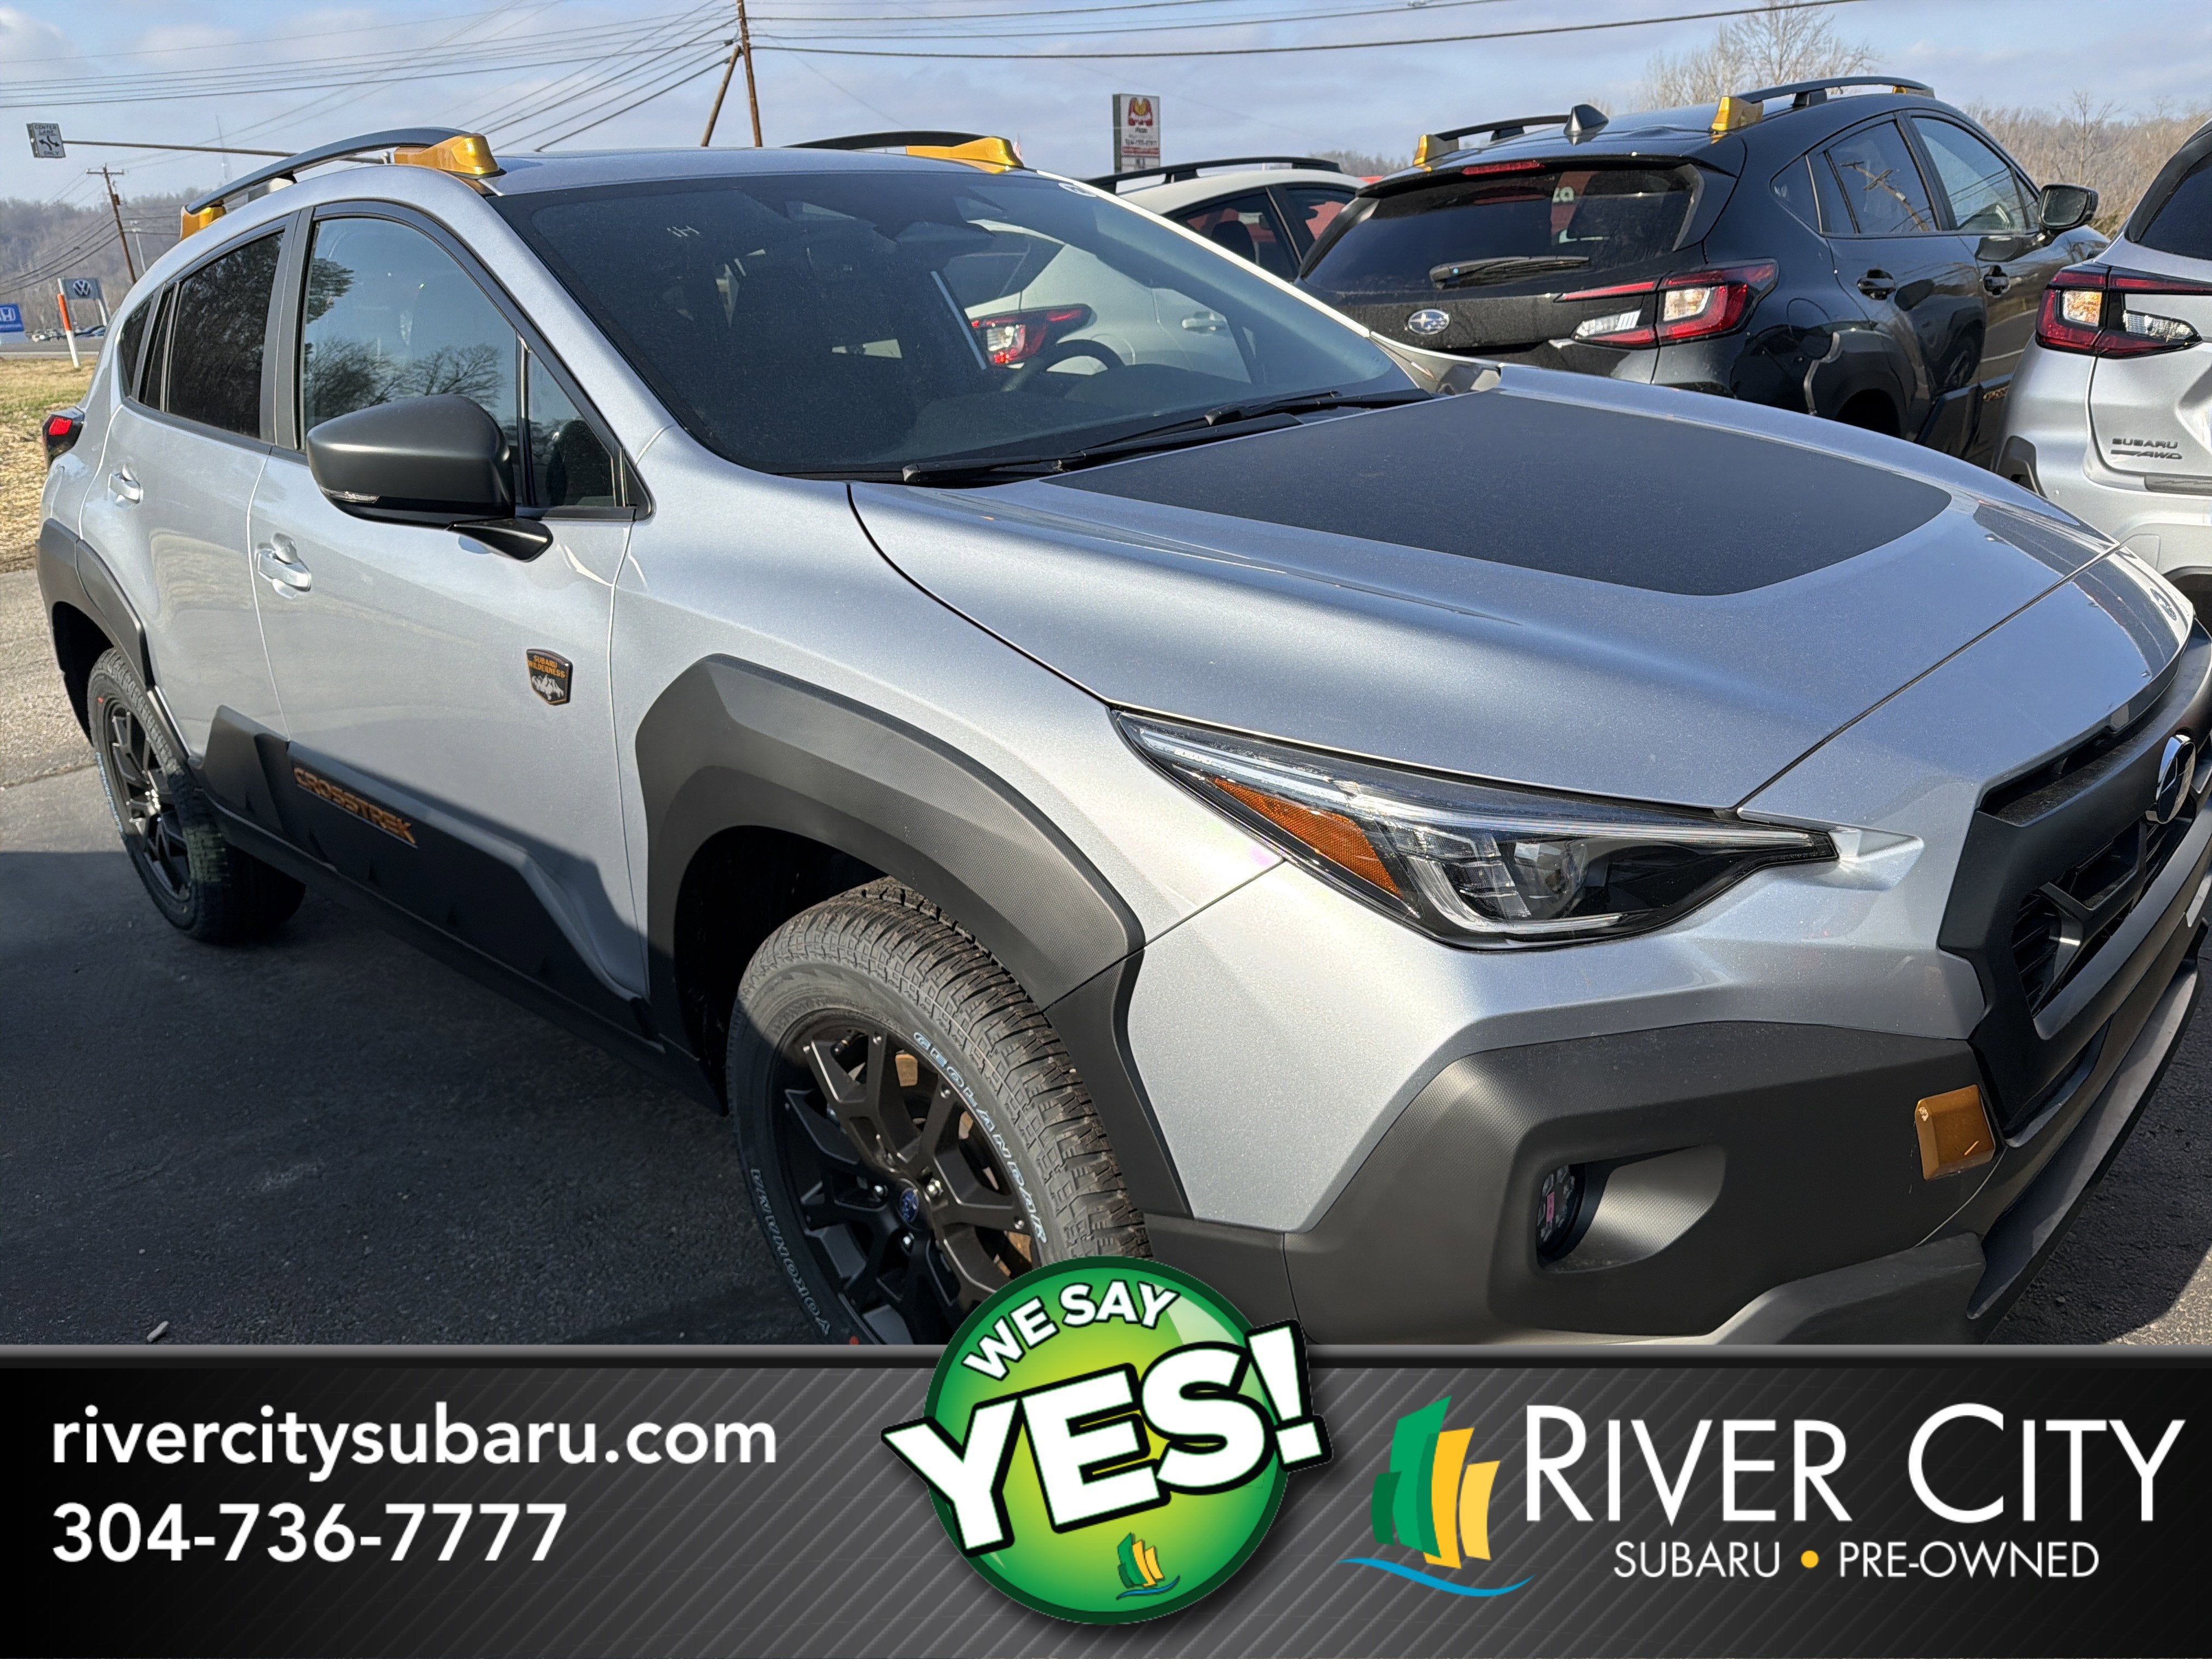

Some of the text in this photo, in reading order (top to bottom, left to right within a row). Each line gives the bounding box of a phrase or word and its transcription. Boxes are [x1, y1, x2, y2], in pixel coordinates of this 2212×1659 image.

[2112, 438, 2178, 449] SUBARU
[2136, 451, 2183, 460] AWD
[528, 660, 566, 678] WILDERNESS
[533, 654, 557, 668] SUBARU
[294, 768, 416, 844] CROSSTREK
[913, 1031, 1047, 1244] GEOLANDAR
[750, 1169, 831, 1336] YOKOHAMA
